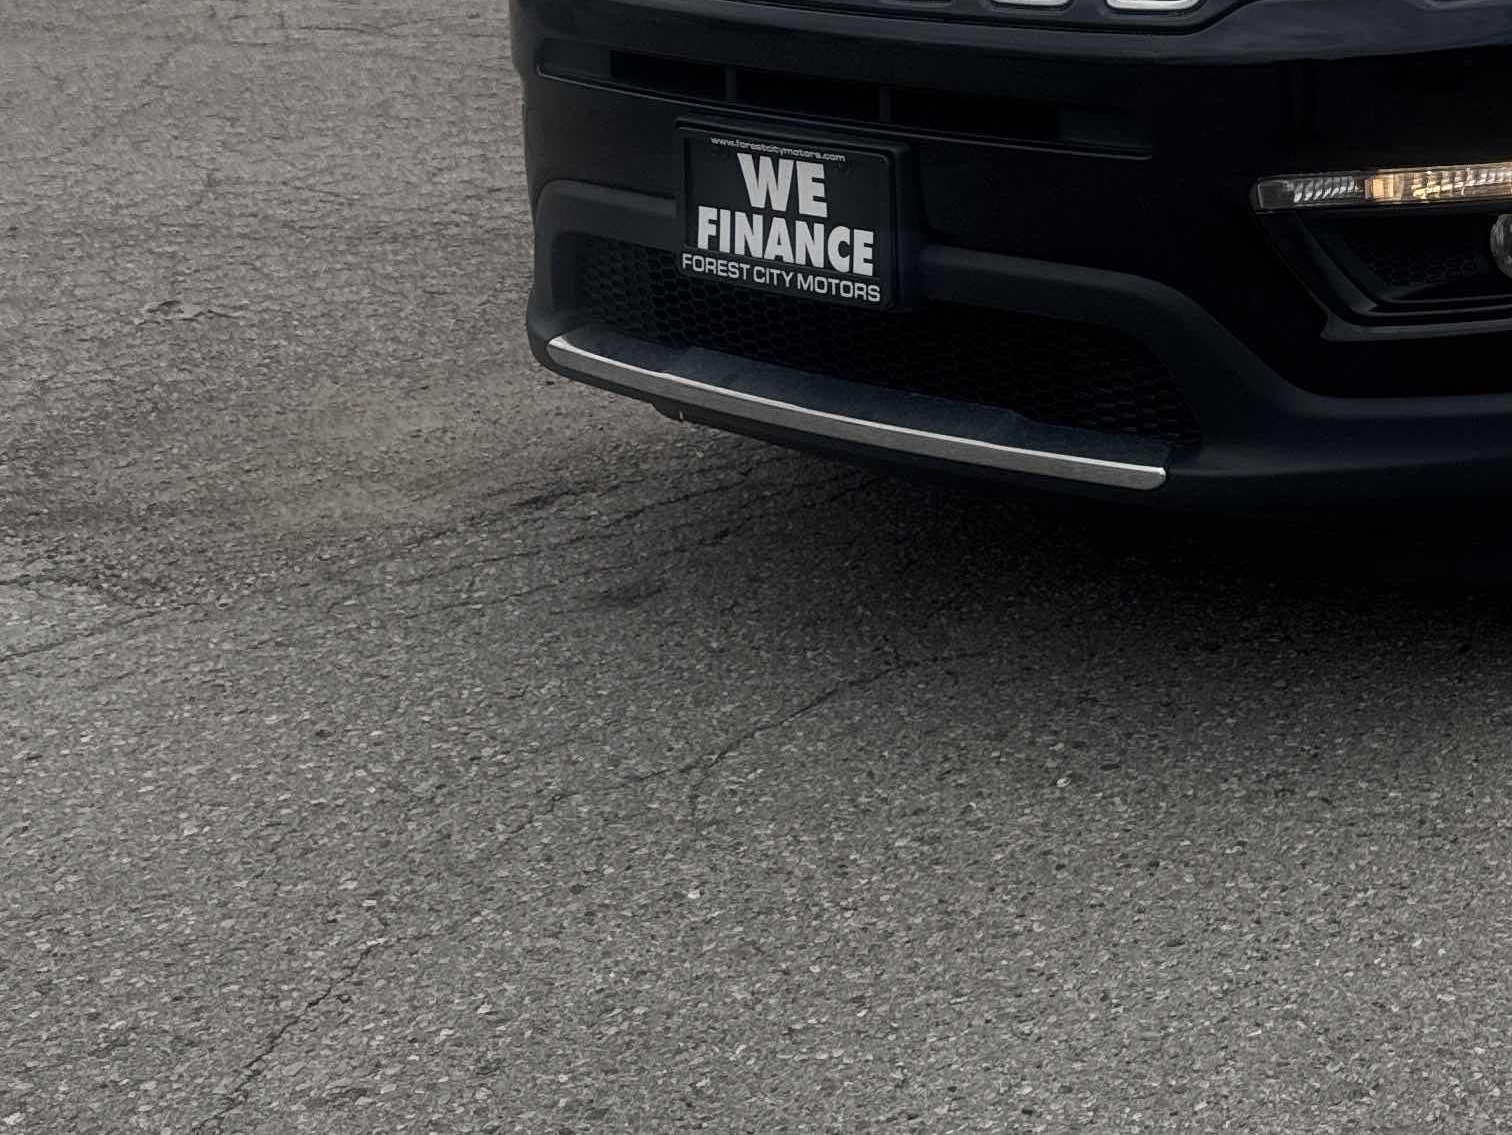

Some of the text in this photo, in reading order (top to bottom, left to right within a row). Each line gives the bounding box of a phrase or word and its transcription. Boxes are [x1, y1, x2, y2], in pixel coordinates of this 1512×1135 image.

[711, 137, 846, 162] www.forestcitymotors.com
[737, 153, 828, 218] WE
[697, 206, 874, 276] FINANCE
[682, 253, 880, 302] FOREST CITY MOTORS
